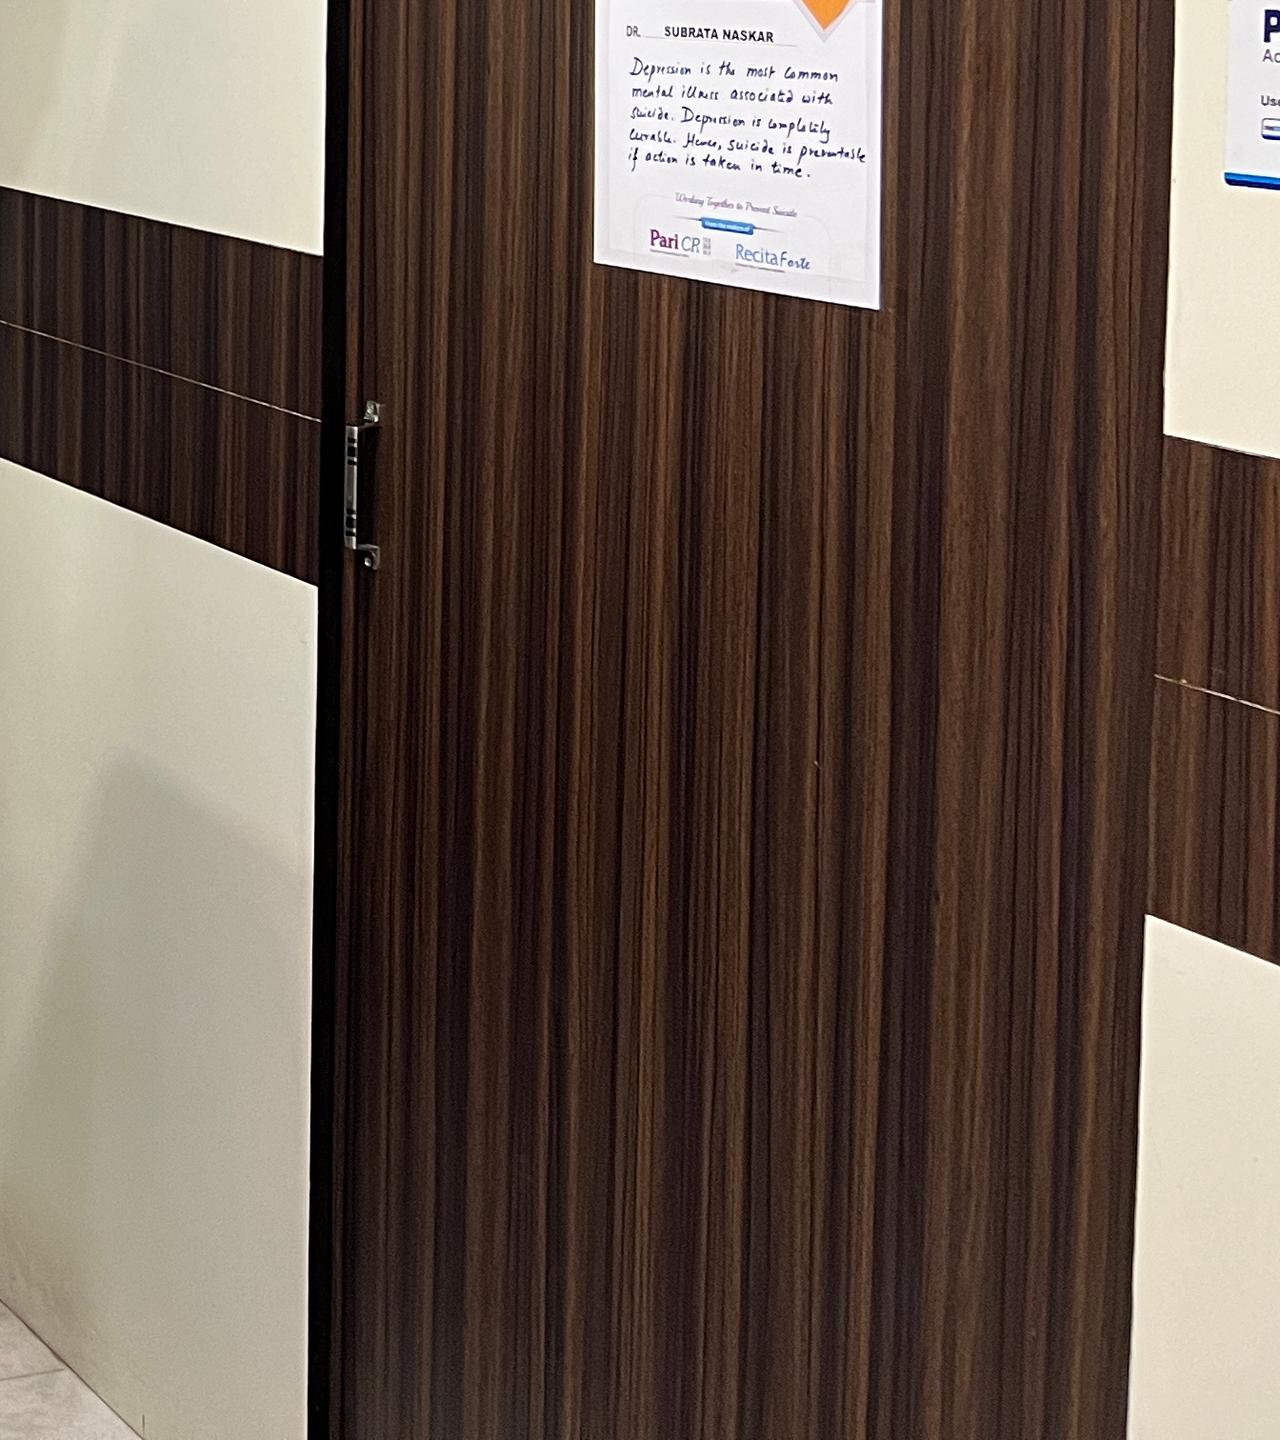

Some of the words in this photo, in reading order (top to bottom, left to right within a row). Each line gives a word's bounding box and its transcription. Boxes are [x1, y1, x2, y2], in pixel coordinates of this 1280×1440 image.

[664, 26, 719, 40] SUBRATA
[722, 29, 775, 44] NASKAR
[629, 56, 692, 84] Depression
[700, 61, 711, 75] is
[718, 60, 735, 76] the
[746, 65, 776, 79] most
[631, 85, 674, 98] mental
[682, 85, 719, 101] illness
[730, 88, 794, 103] associated
[801, 90, 834, 105] with
[680, 106, 746, 135] Depression
[752, 115, 762, 128] is
[628, 147, 639, 172] if
[645, 150, 678, 164] action
[685, 154, 696, 166] is
[702, 154, 741, 171] taken
[751, 158, 762, 171] in
[727, 139, 775, 156] suicide
[782, 142, 792, 155] is
[796, 145, 867, 166] preventable
[707, 196, 734, 209] Together
[650, 228, 679, 250] Pari
[681, 235, 701, 253] CR
